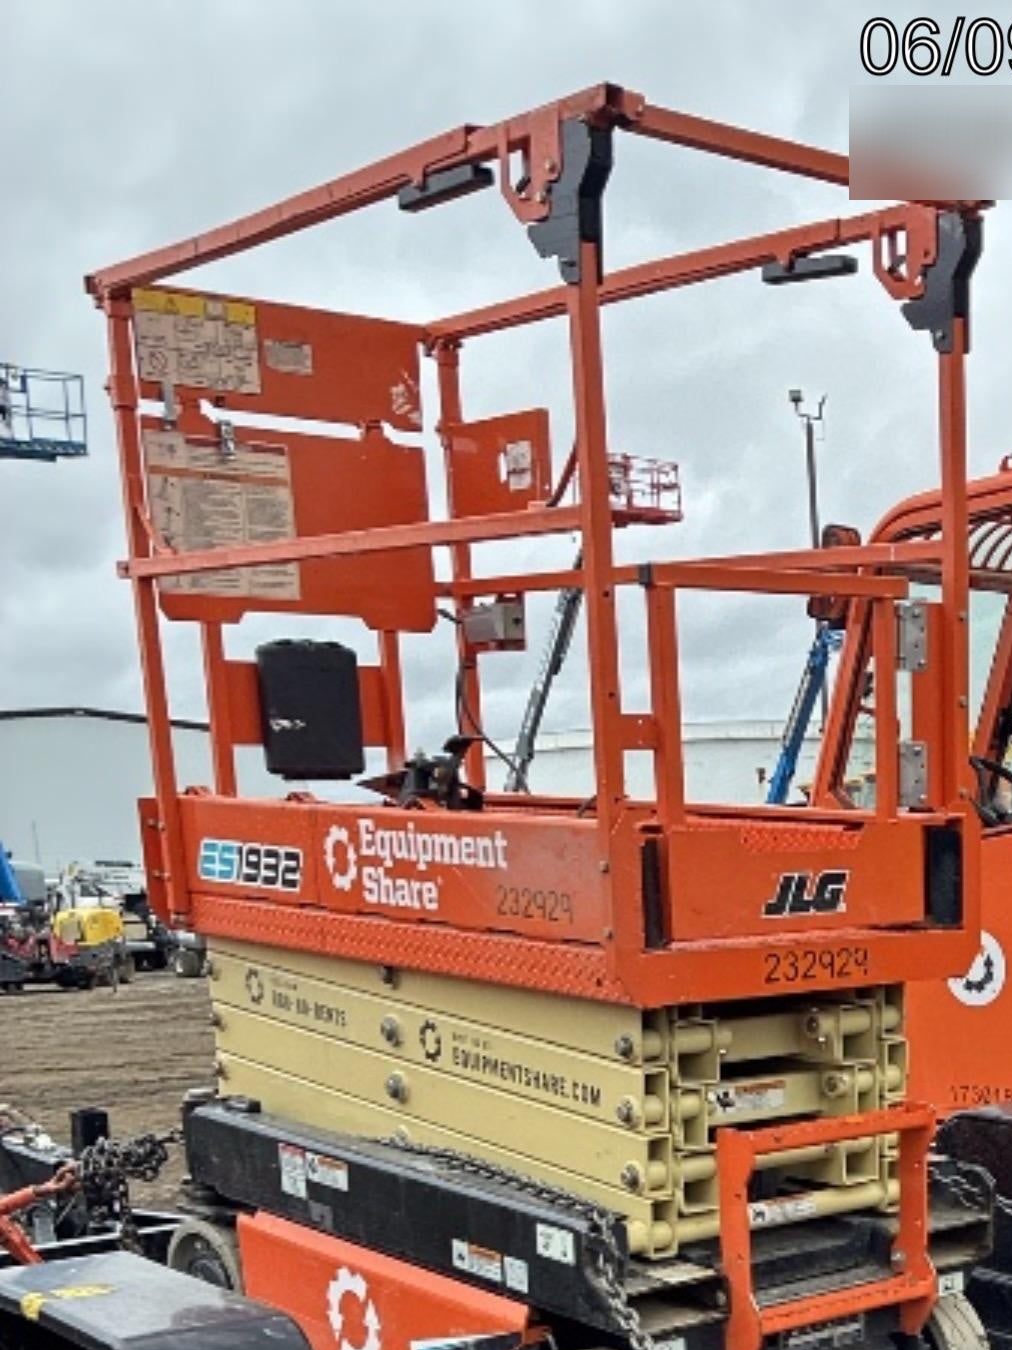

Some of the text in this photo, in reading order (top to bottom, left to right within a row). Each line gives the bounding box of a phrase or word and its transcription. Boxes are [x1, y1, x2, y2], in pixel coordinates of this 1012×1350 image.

[198, 837, 303, 893] ES1932
[358, 819, 508, 869] Equipment
[361, 866, 440, 912] Share
[496, 884, 574, 925] 232929
[761, 869, 850, 918] JLG
[764, 947, 869, 984] 232929
[451, 1046, 601, 1105] EQUIPMENTSHARE.COM
